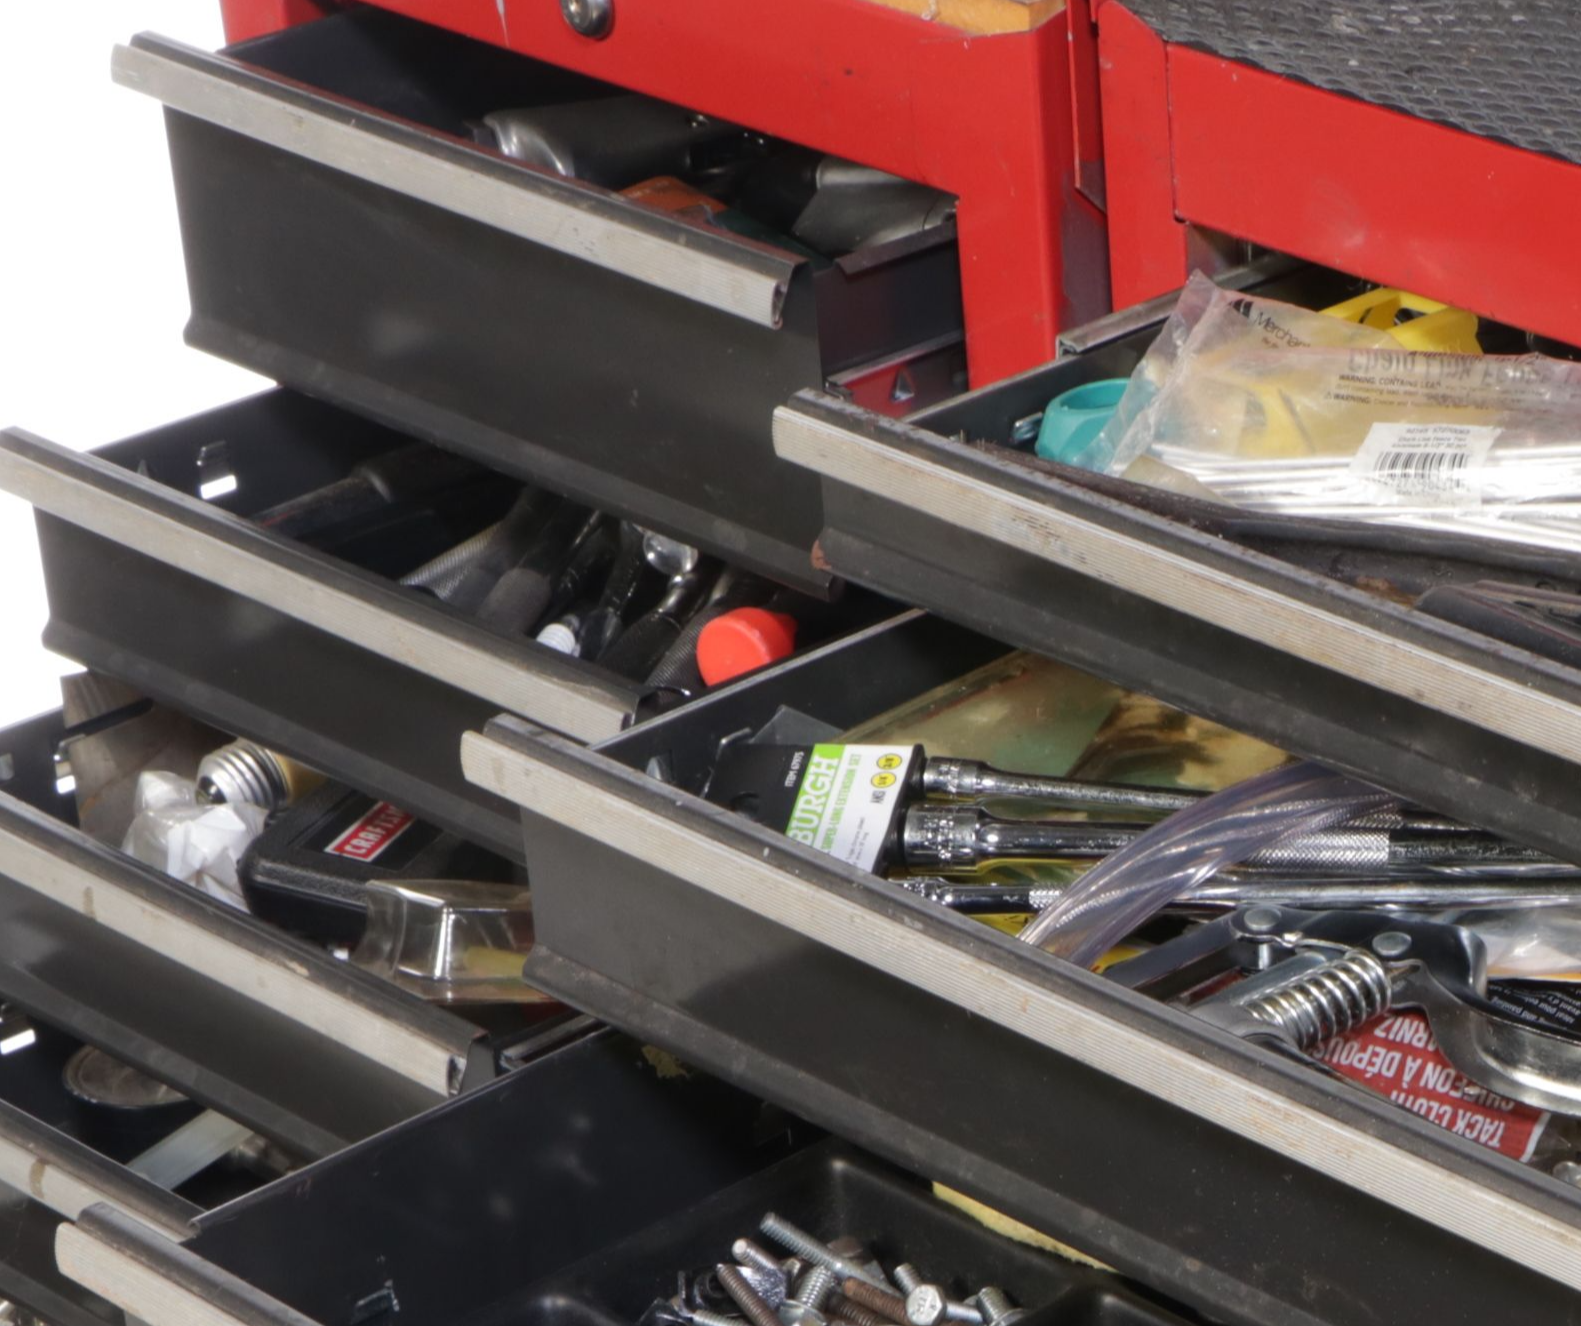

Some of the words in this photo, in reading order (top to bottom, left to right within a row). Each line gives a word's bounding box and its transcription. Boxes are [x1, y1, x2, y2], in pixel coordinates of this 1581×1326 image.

[1339, 374, 1377, 386] WARNING:
[1379, 376, 1418, 388] CONTAINS
[1398, 1054, 1422, 1090] À
[1451, 1108, 1504, 1148] TACK
